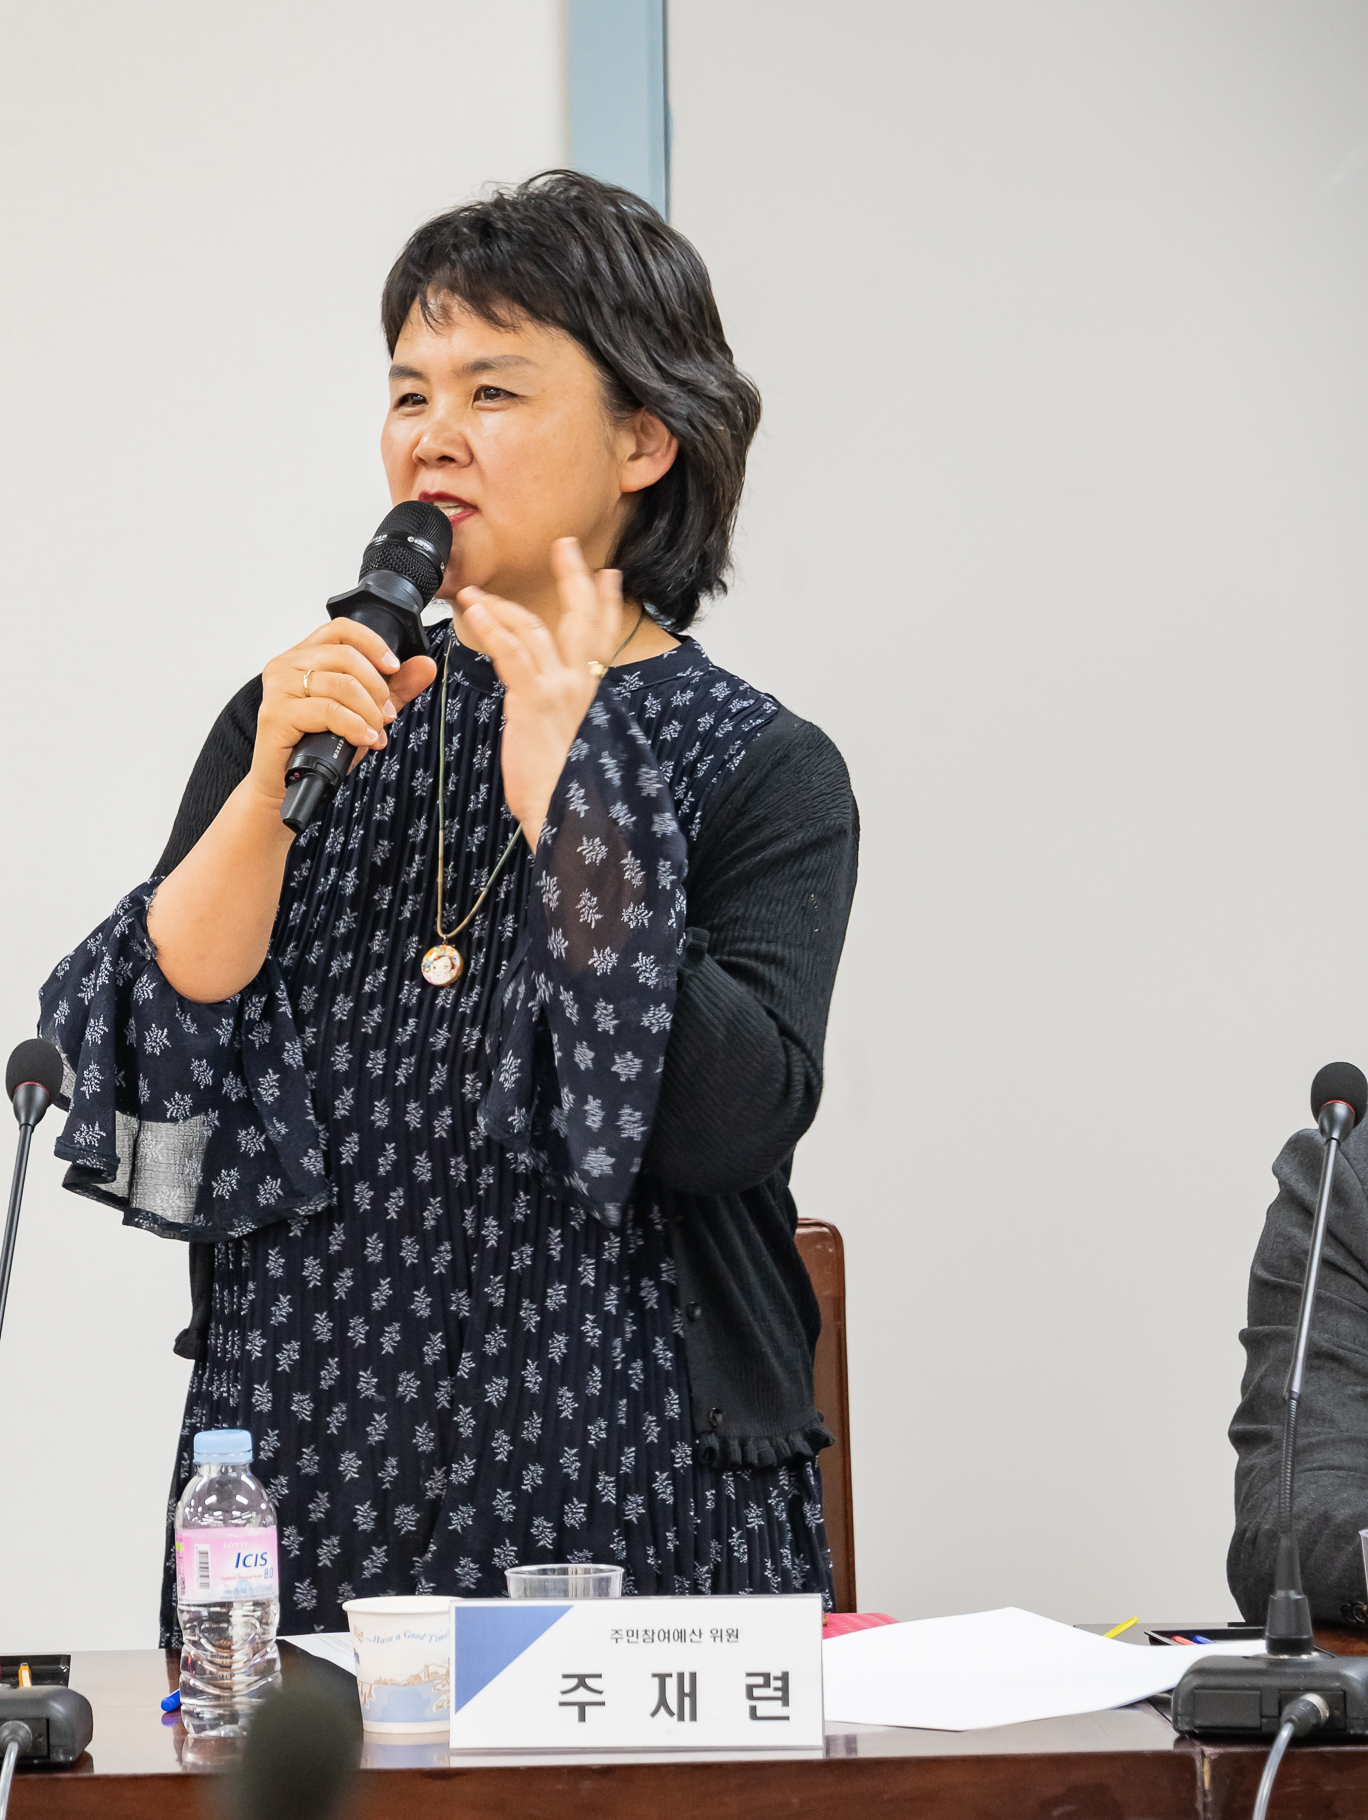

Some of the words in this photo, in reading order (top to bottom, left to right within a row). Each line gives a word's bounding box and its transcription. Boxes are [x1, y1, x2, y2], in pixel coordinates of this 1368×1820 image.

[235, 1551, 268, 1569] ICIS
[404, 1630, 426, 1641] Good
[610, 1628, 703, 1644] 주민참여예산
[710, 1628, 738, 1642] 위원
[558, 1674, 605, 1722] 주
[650, 1672, 697, 1722] 재
[746, 1671, 790, 1721] 련
